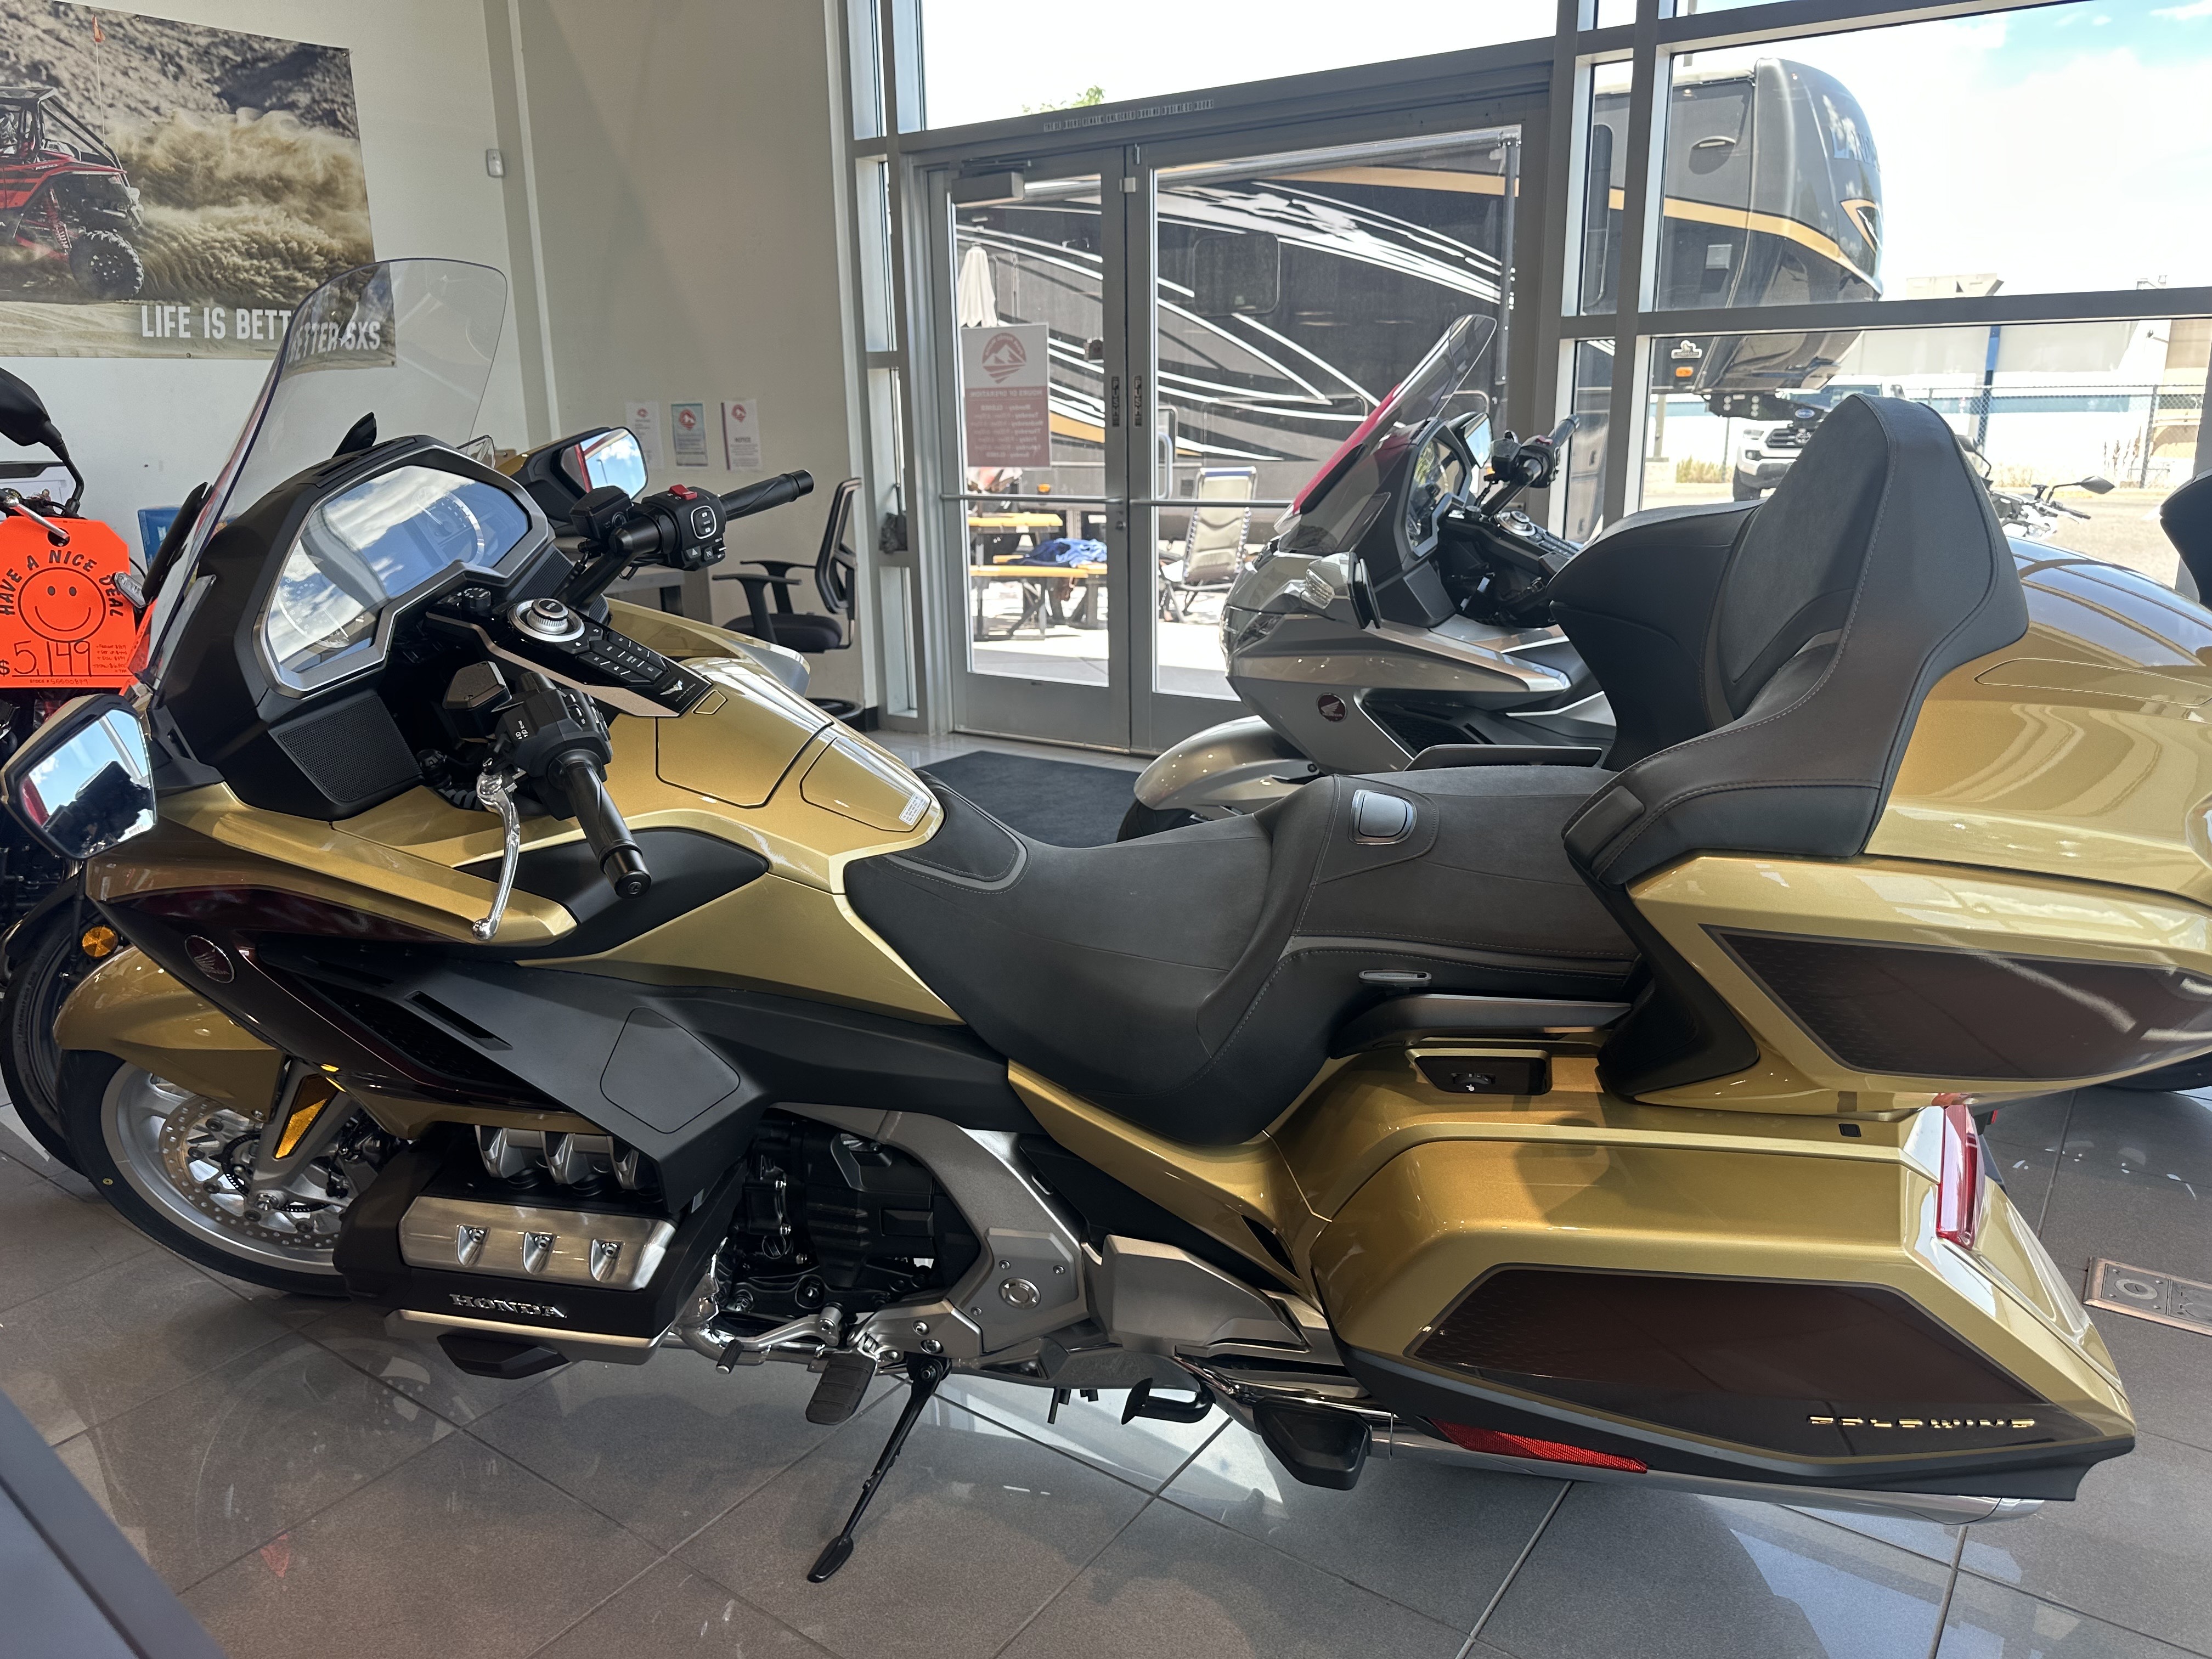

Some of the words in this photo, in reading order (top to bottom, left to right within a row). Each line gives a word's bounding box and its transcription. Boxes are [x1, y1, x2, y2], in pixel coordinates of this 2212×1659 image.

[141, 305, 191, 338] LIFE
[204, 307, 225, 339] IS
[236, 308, 294, 340] BETT
[345, 320, 381, 351] SXS
[0, 568, 22, 615] HAVE
[27, 555, 40, 571] A
[48, 549, 98, 572] NICE
[98, 574, 124, 617] DEAL
[449, 1293, 568, 1319] HONDA
[1807, 1415, 2036, 1430] GOLDWING
